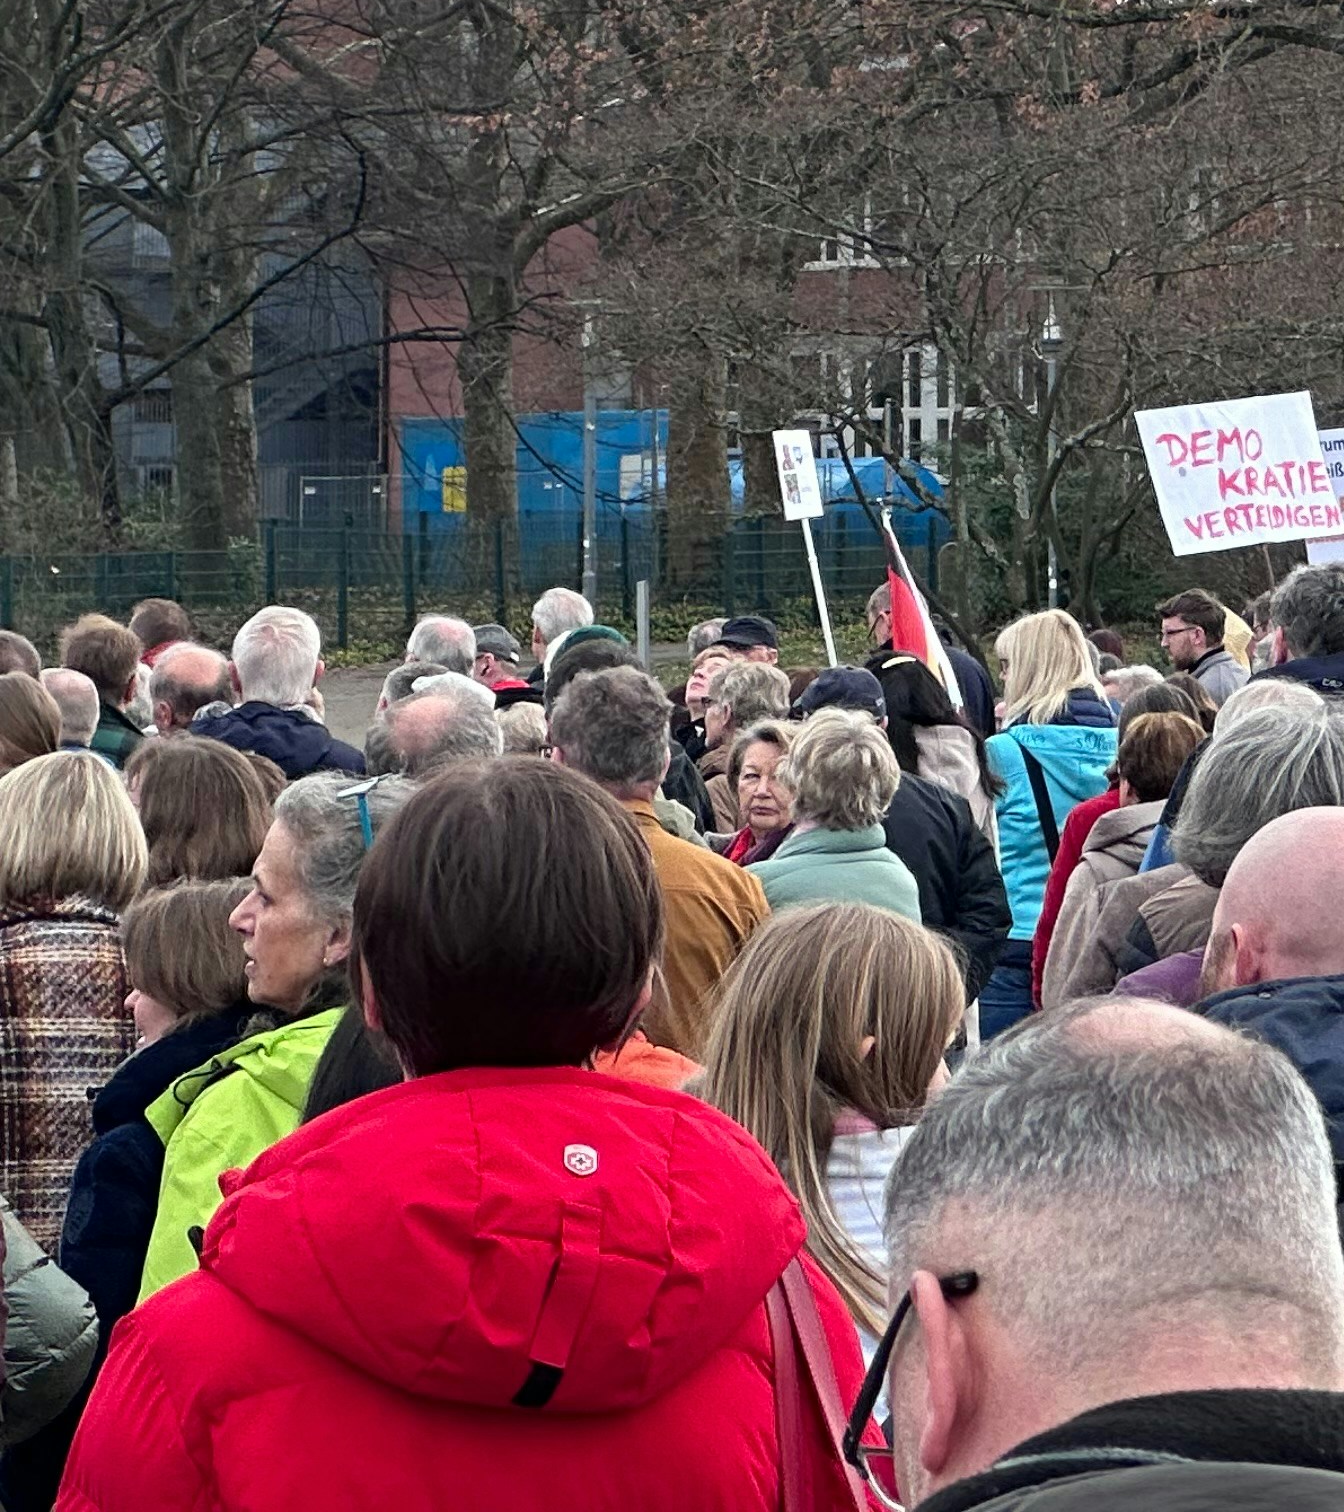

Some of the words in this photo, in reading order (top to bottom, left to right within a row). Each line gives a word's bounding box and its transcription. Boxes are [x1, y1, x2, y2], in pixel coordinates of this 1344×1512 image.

[1155, 426, 1263, 468] DEMO
[1217, 460, 1330, 502] KRATIE
[1183, 502, 1342, 541] VERTEIDIGEN
